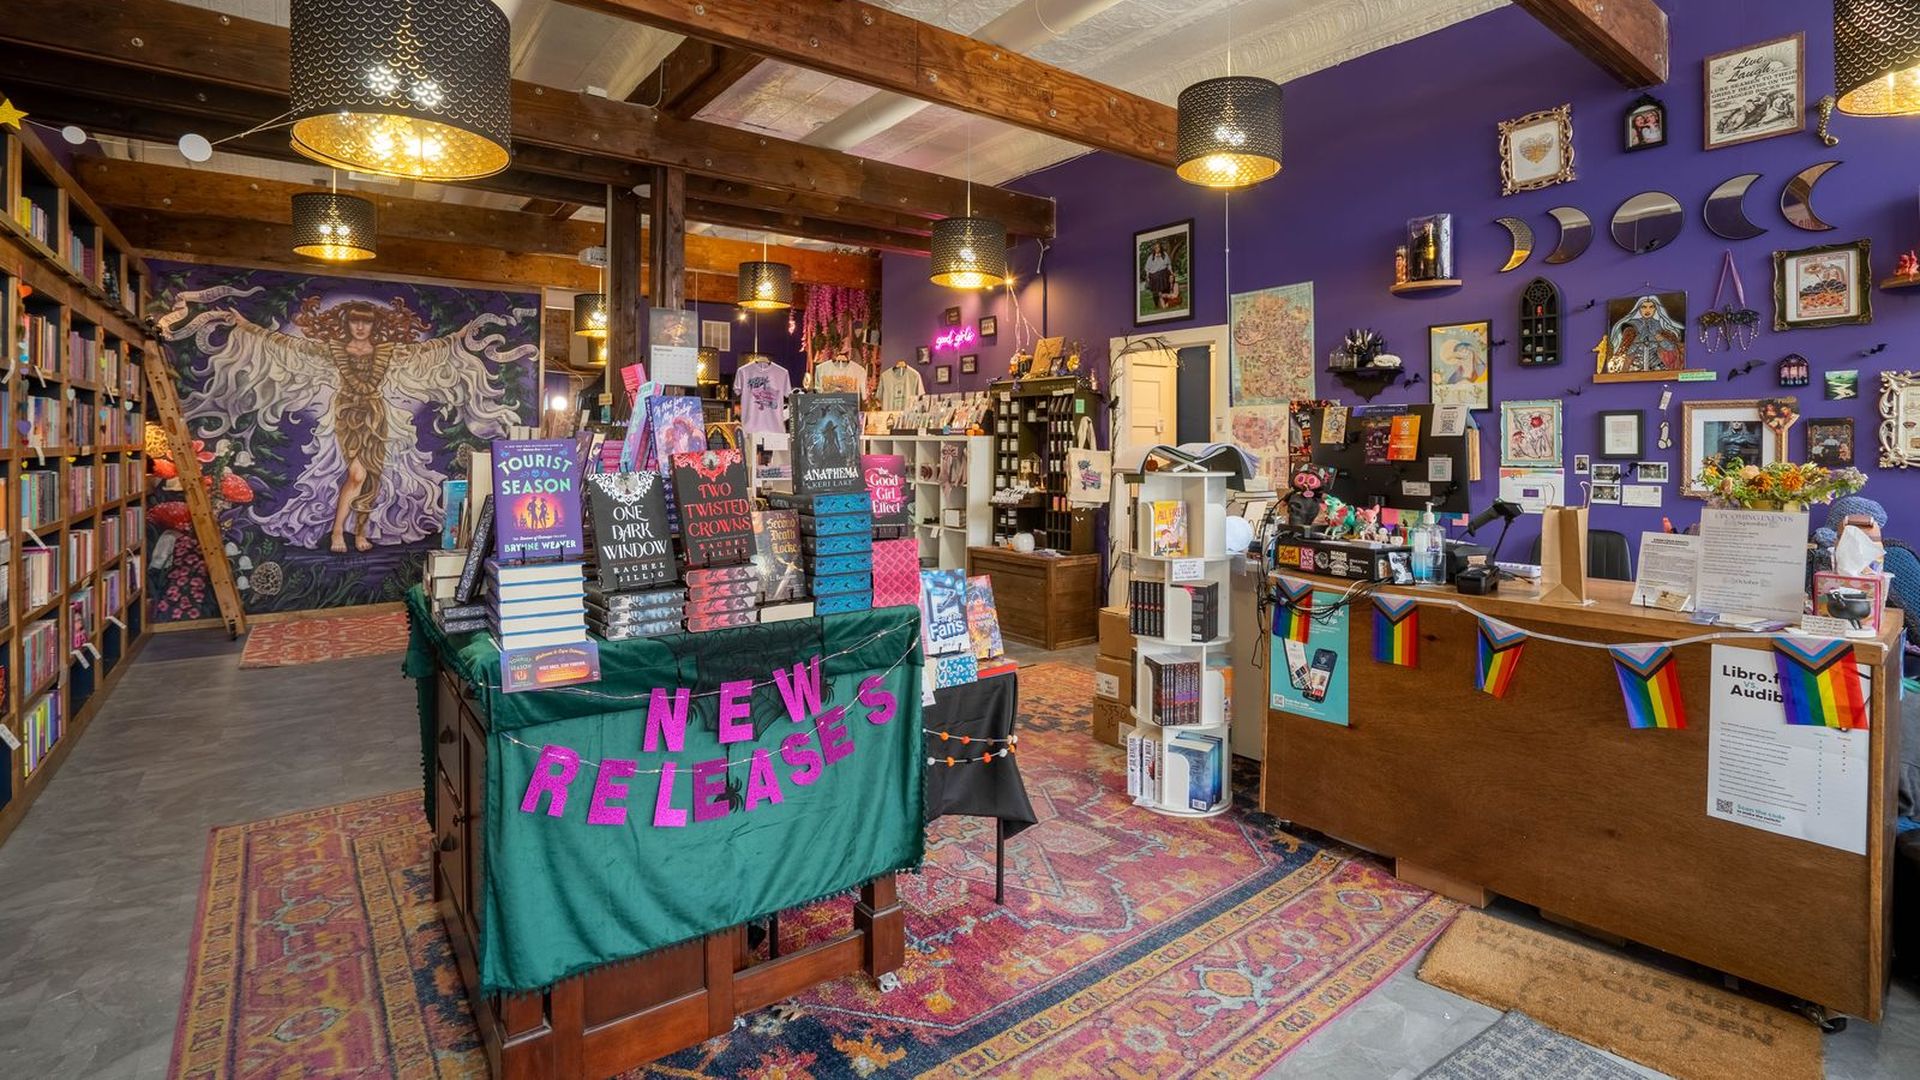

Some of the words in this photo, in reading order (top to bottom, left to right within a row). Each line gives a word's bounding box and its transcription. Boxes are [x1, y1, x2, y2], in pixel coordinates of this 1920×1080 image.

[1726, 61, 1775, 83] Laugh.
[497, 453, 573, 477] TOURIST
[803, 466, 859, 481] ANATHEMA
[877, 466, 889, 475] the
[501, 478, 571, 495] SEASON
[869, 473, 899, 486] Good
[698, 482, 733, 499] TWO
[876, 486, 895, 500] Girl
[613, 504, 649, 522] ONE
[684, 498, 751, 519] TWISTED
[871, 499, 900, 514] Effect
[688, 516, 752, 537] CROWNS
[766, 518, 797, 530] Second
[1760, 514, 1794, 523] EVENTS
[611, 522, 655, 542] DARK
[769, 529, 796, 541] Death
[541, 540, 577, 550] WEAVER
[602, 539, 668, 560] WINDOW
[699, 538, 749, 550] RACHEL
[771, 542, 798, 554] Locke
[613, 561, 666, 575] RACHEL
[929, 620, 966, 642] Fans
[1721, 664, 1780, 685] Libro.f
[1730, 684, 1785, 703] Audib
[642, 654, 823, 753] NEW
[519, 674, 898, 828] RELEASES
